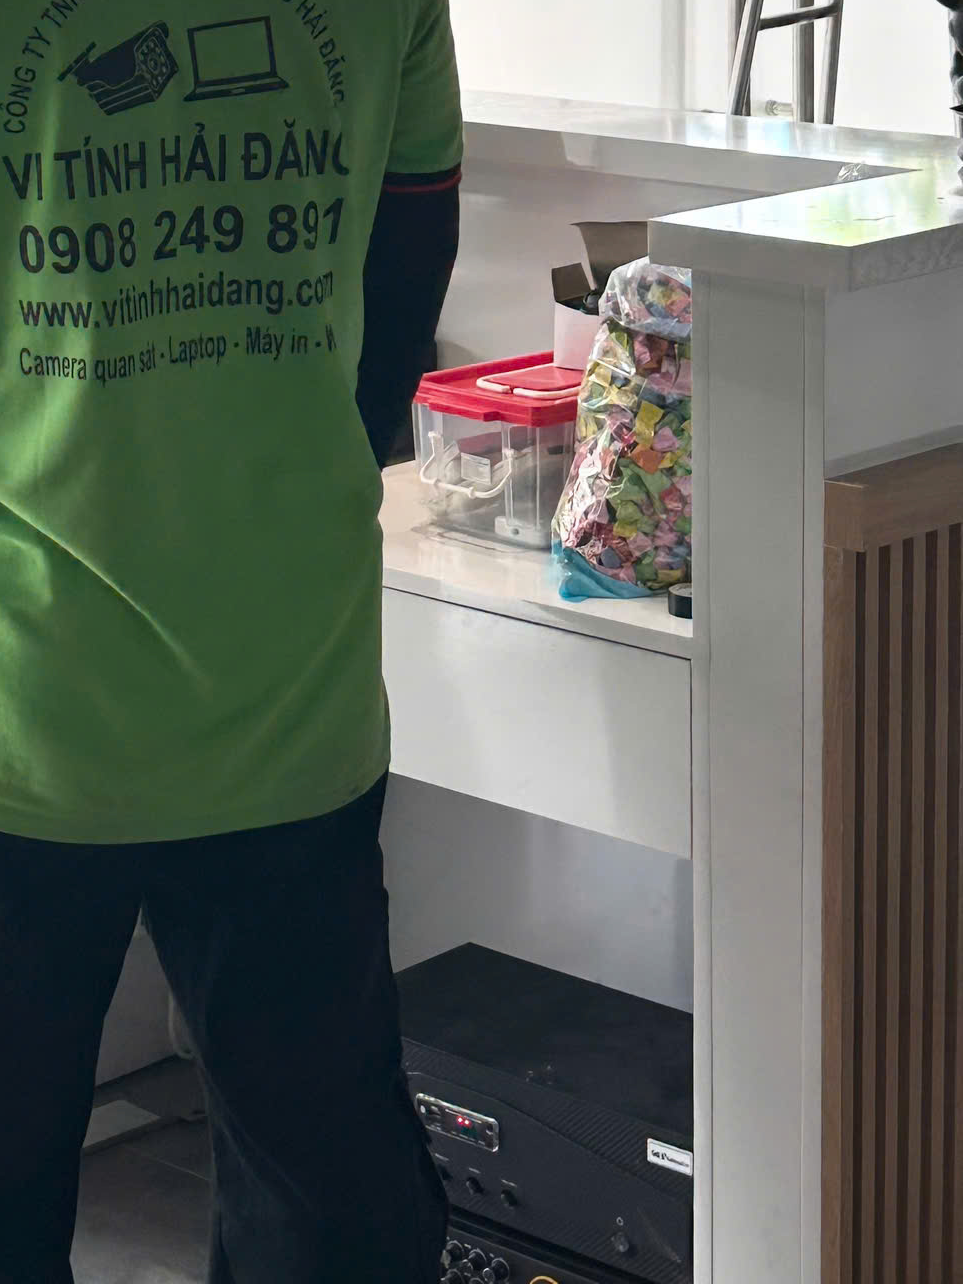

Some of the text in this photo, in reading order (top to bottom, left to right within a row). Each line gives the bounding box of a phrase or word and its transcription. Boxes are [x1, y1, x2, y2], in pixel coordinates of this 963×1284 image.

[22, 26, 52, 60] TY
[2, 152, 43, 201] VI
[54, 136, 147, 200] TÍNH
[160, 121, 227, 187] HẢI
[19, 197, 344, 274] 0908 249 891
[19, 270, 333, 328] www.vitinhhaidang.com
[20, 347, 87, 380] Camera
[94, 354, 136, 388] quan
[168, 333, 227, 366] Laptop
[246, 326, 285, 361] Máy
[291, 327, 308, 354] in
